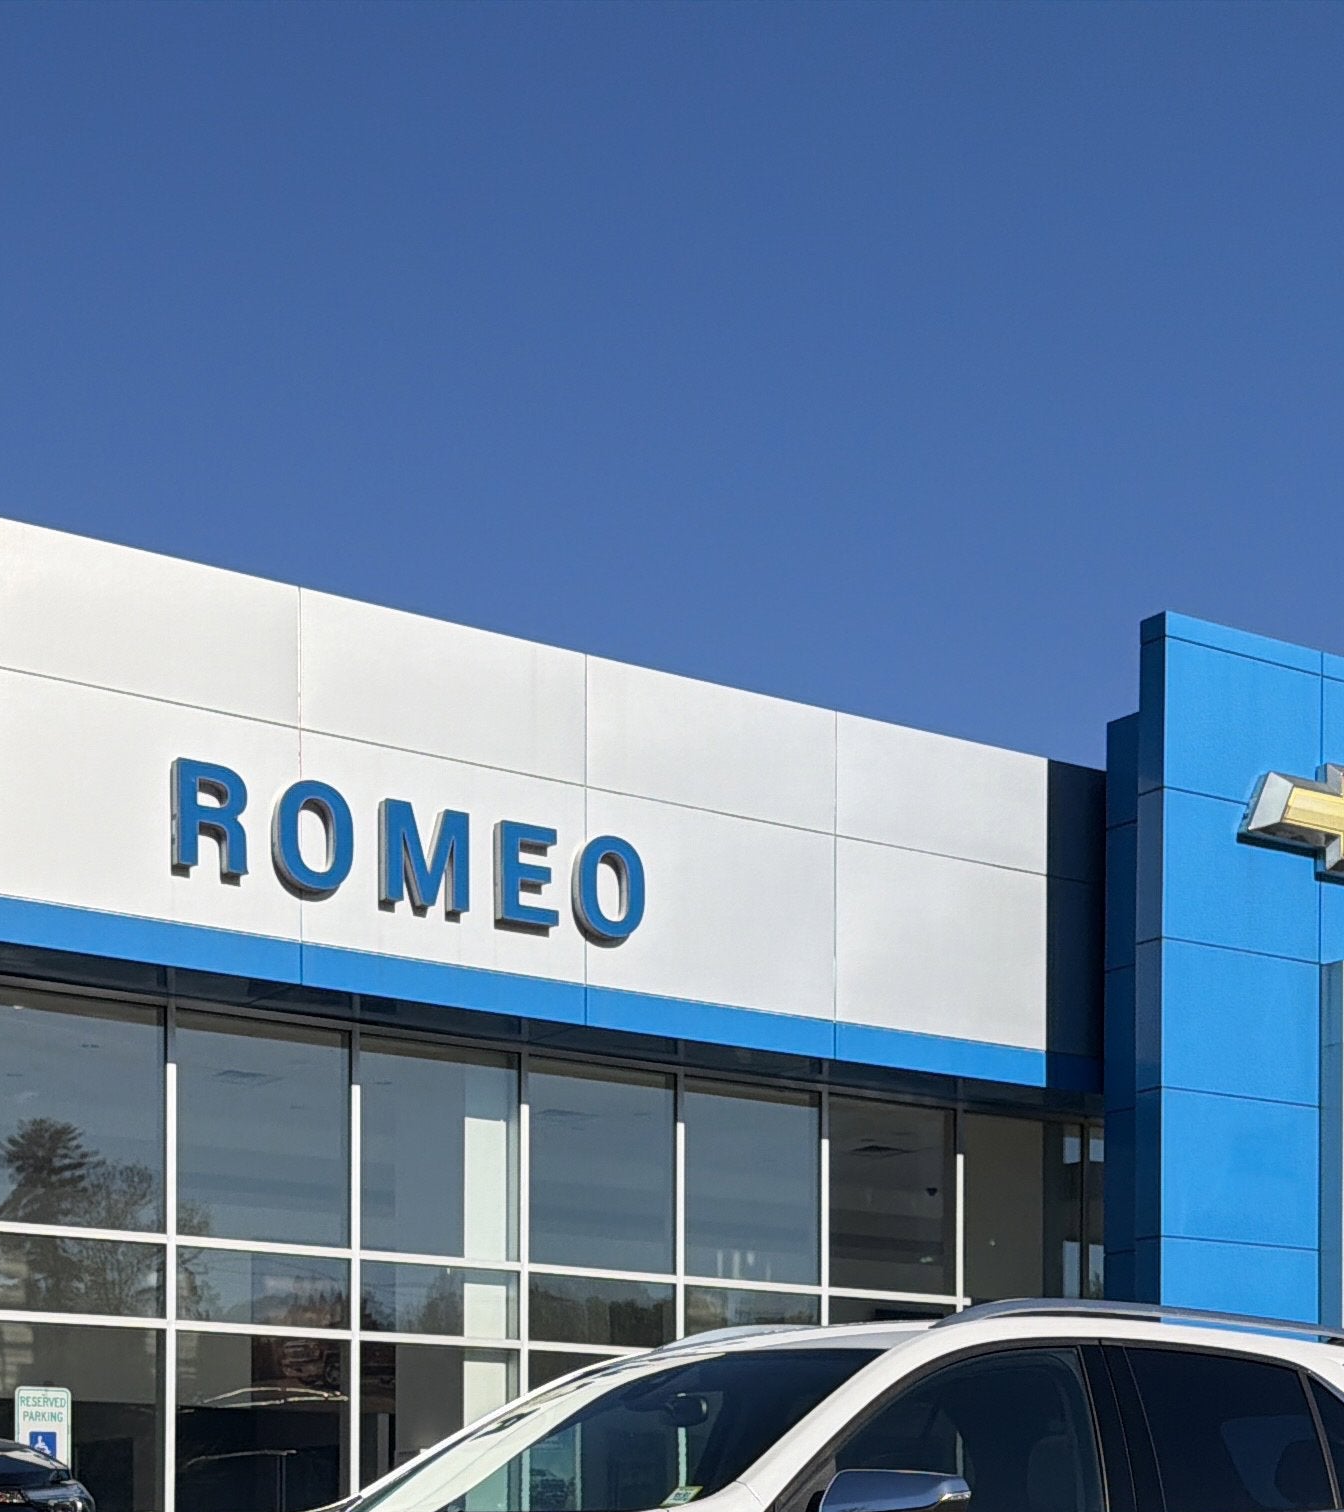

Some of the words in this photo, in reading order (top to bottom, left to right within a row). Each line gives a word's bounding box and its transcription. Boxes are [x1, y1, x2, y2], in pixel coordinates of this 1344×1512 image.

[171, 757, 646, 946] ROMEO
[20, 1396, 67, 1408] RESERVED
[22, 1411, 64, 1423] PARKING
